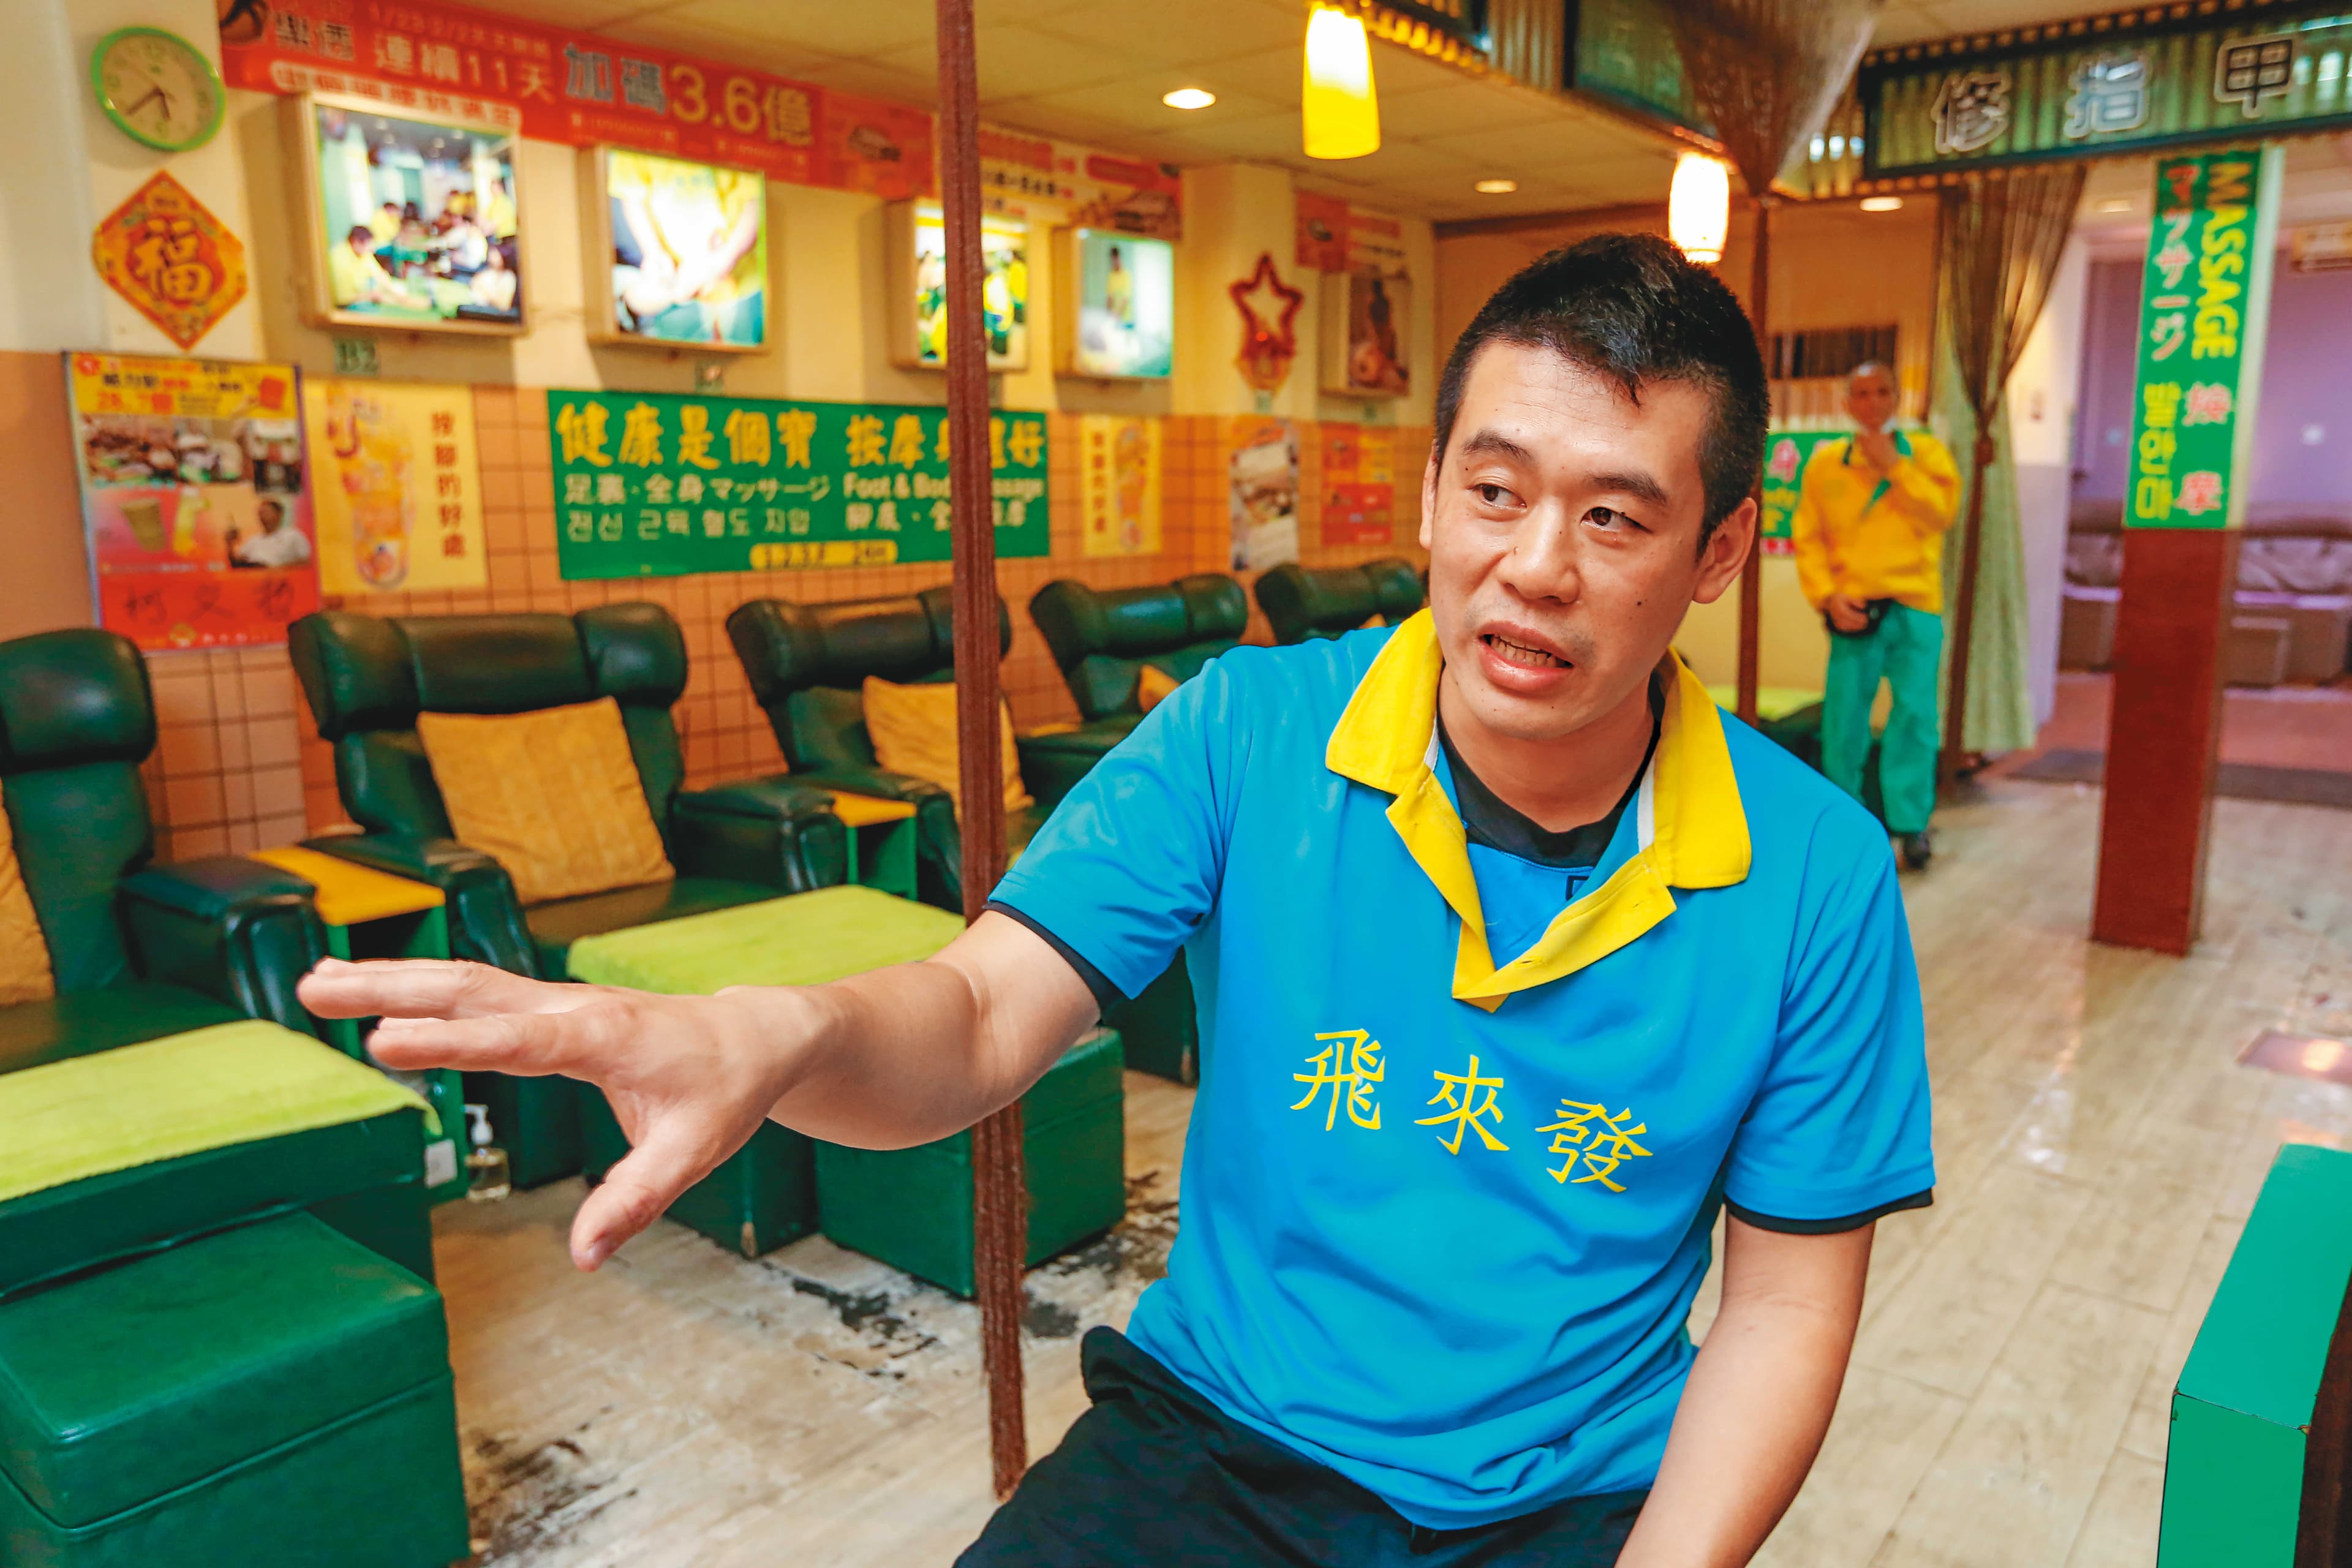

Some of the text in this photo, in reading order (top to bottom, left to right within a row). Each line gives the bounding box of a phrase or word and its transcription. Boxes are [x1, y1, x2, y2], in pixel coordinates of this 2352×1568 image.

[131, 218, 216, 303] 福
[2190, 160, 2253, 361] MASSAGE
[555, 400, 817, 470] 健康是個寶
[1289, 1028, 1654, 1193] 飛來發
